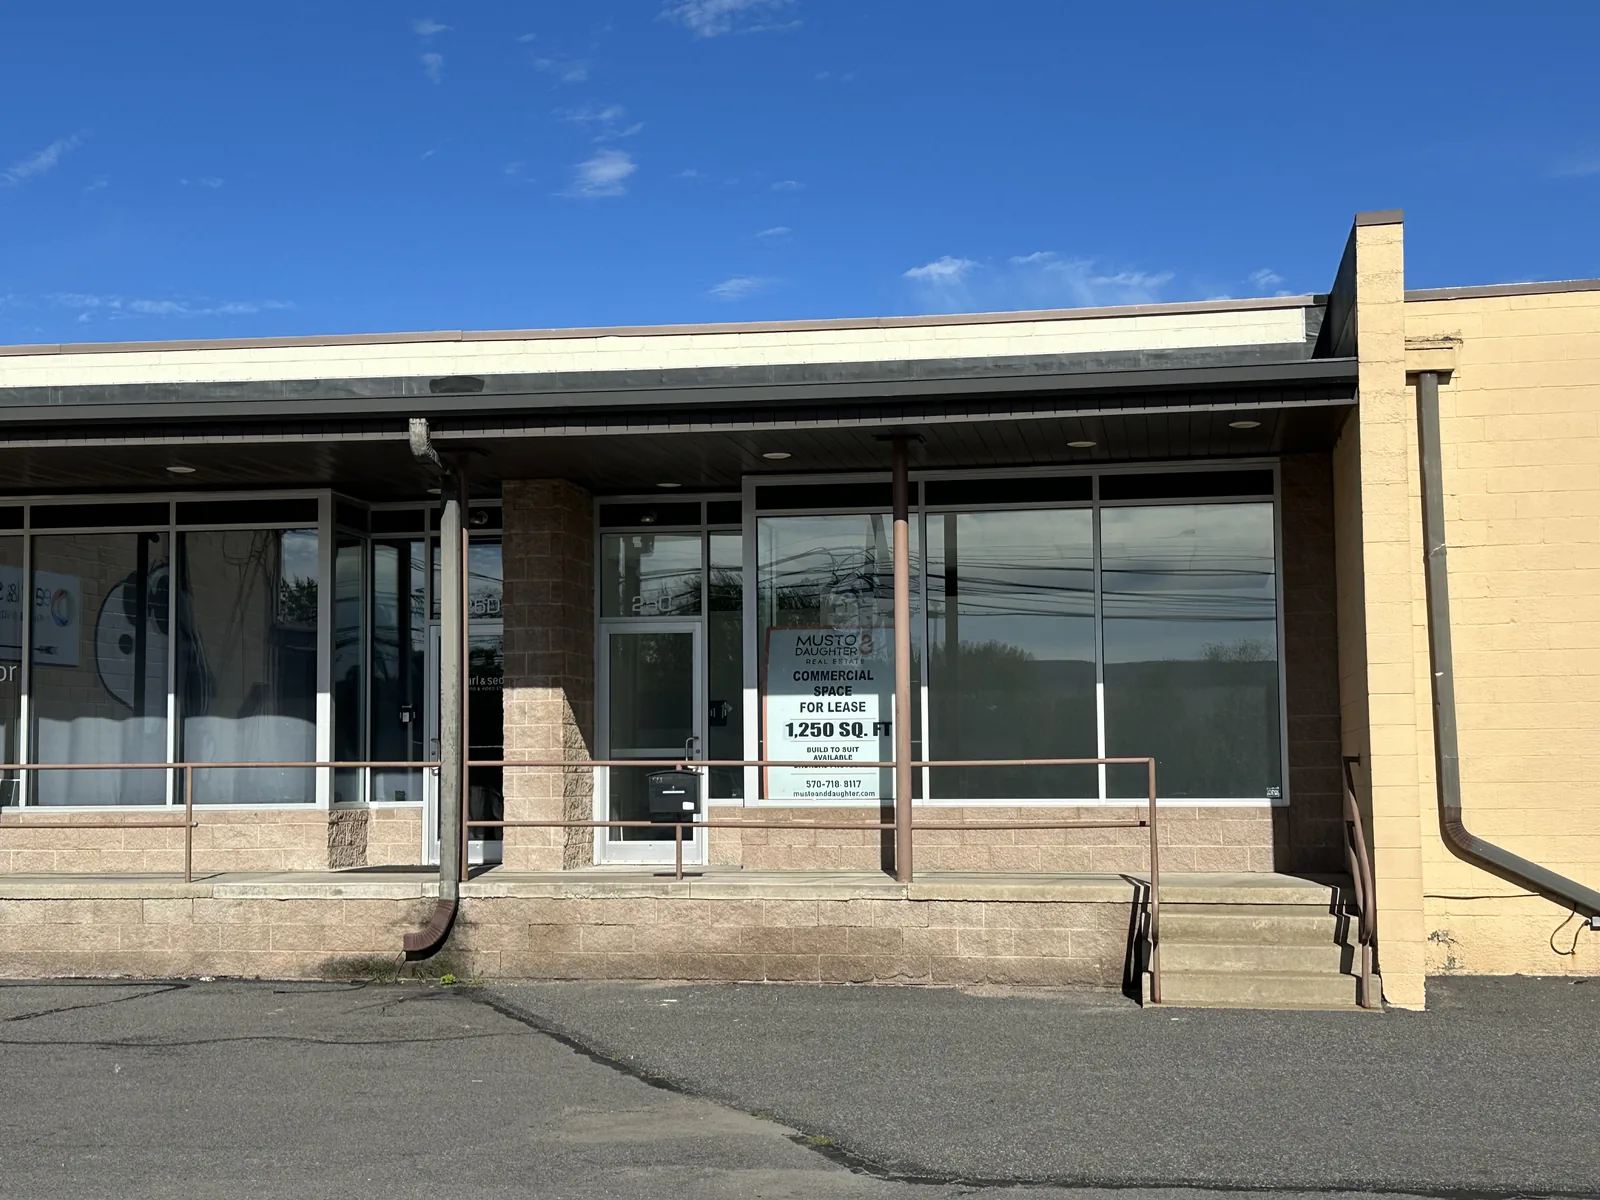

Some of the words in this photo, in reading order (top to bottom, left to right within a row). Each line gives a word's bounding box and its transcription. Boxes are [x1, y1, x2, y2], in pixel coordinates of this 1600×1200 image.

[795, 634, 857, 646] MUSTO
[795, 647, 858, 656] DAUGHTER
[792, 670, 874, 681] COMMERCIAL
[813, 685, 853, 697] SPACE
[799, 702, 824, 713] FOR
[828, 701, 866, 713] LEASE
[785, 722, 834, 738] 1,250
[839, 721, 868, 738] SQ.
[793, 790, 876, 798] mustoanddaughter.com
